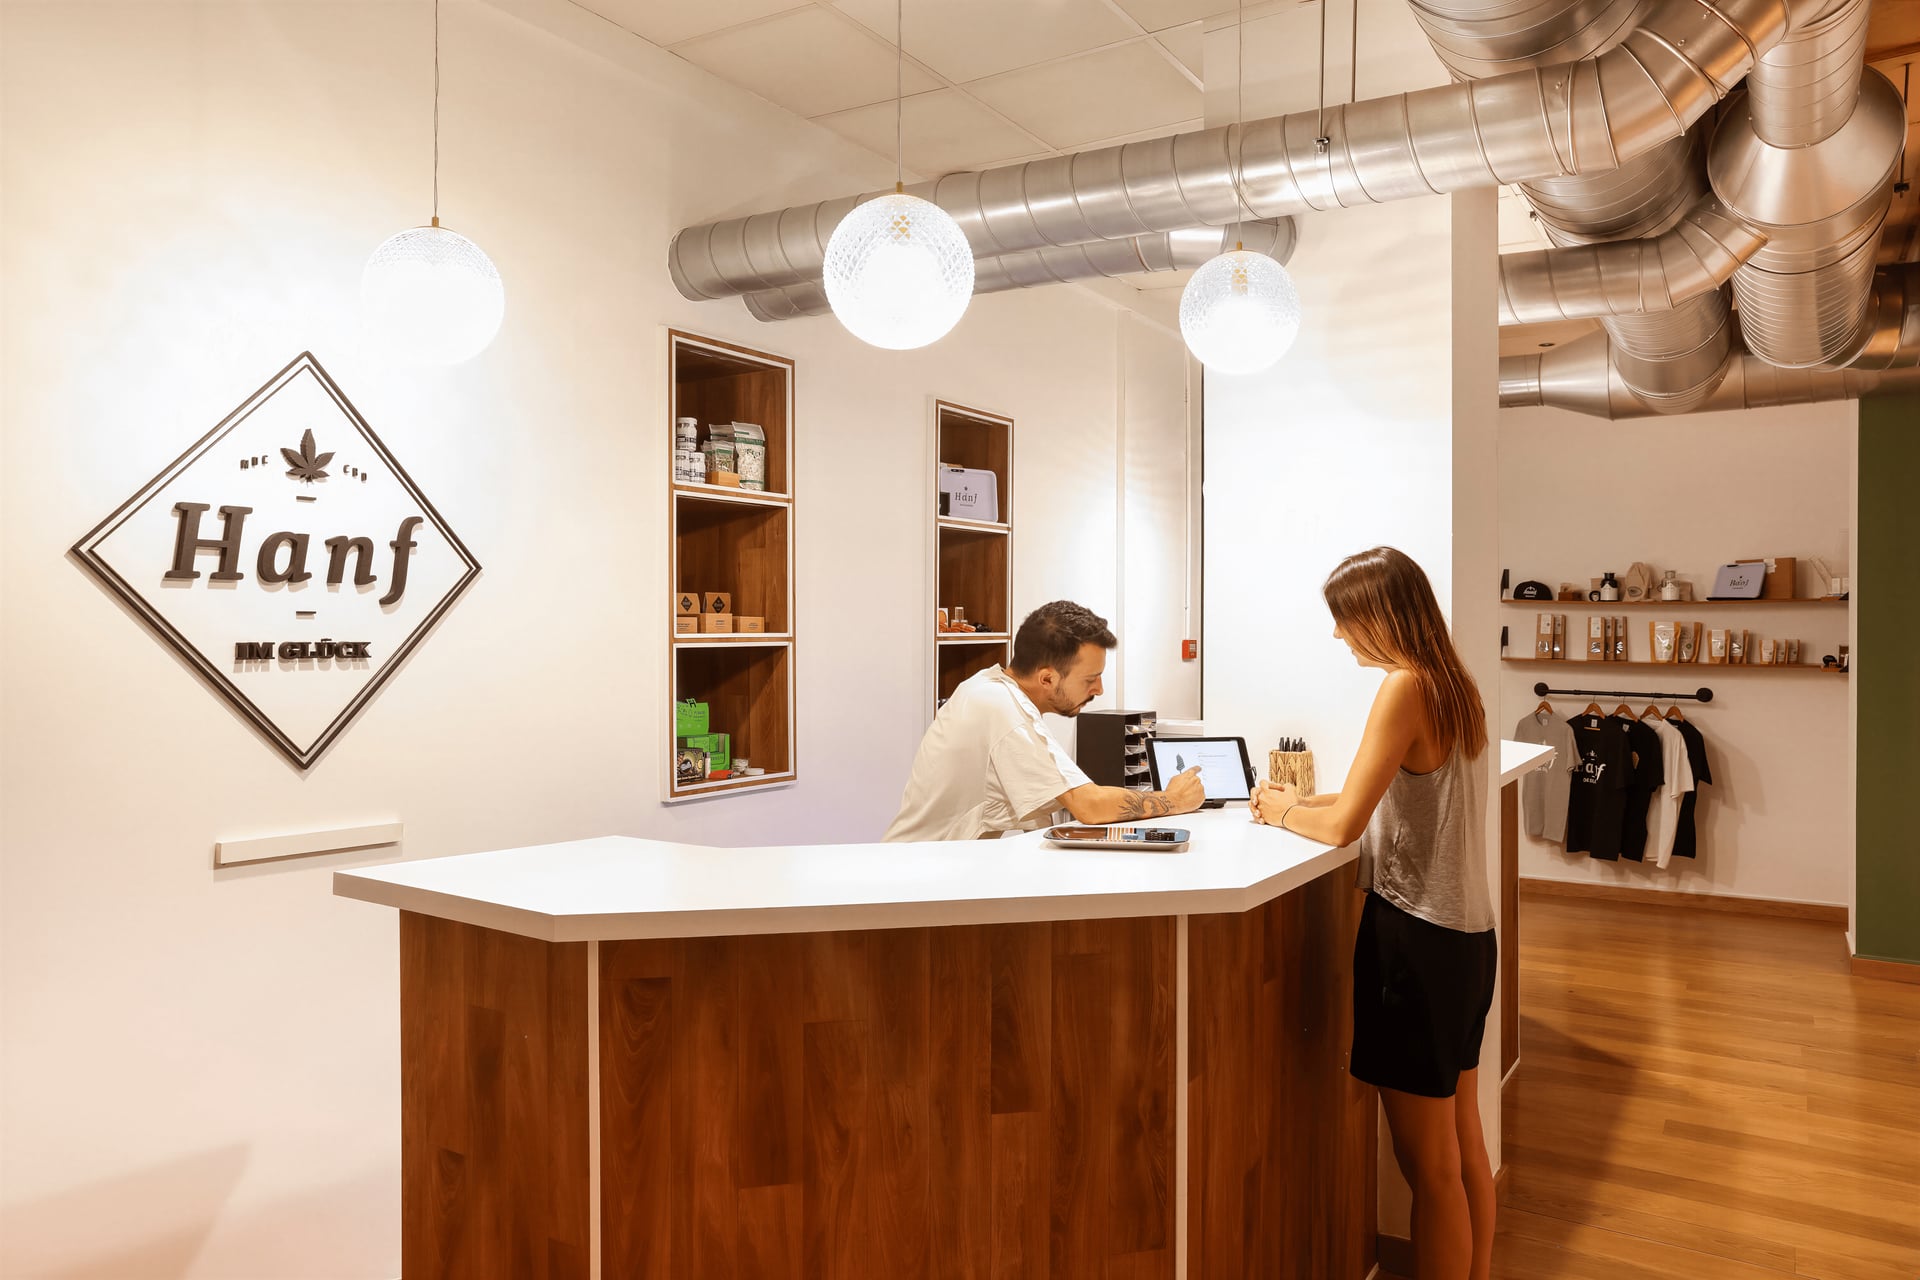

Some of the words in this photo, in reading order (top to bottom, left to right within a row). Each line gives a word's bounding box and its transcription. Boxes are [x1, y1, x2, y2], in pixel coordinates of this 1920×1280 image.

[342, 464, 368, 481] CBD
[955, 491, 978, 505] Hanf
[164, 501, 424, 605] Hanf
[234, 641, 275, 660] IM
[278, 637, 372, 660] GLÜCK
